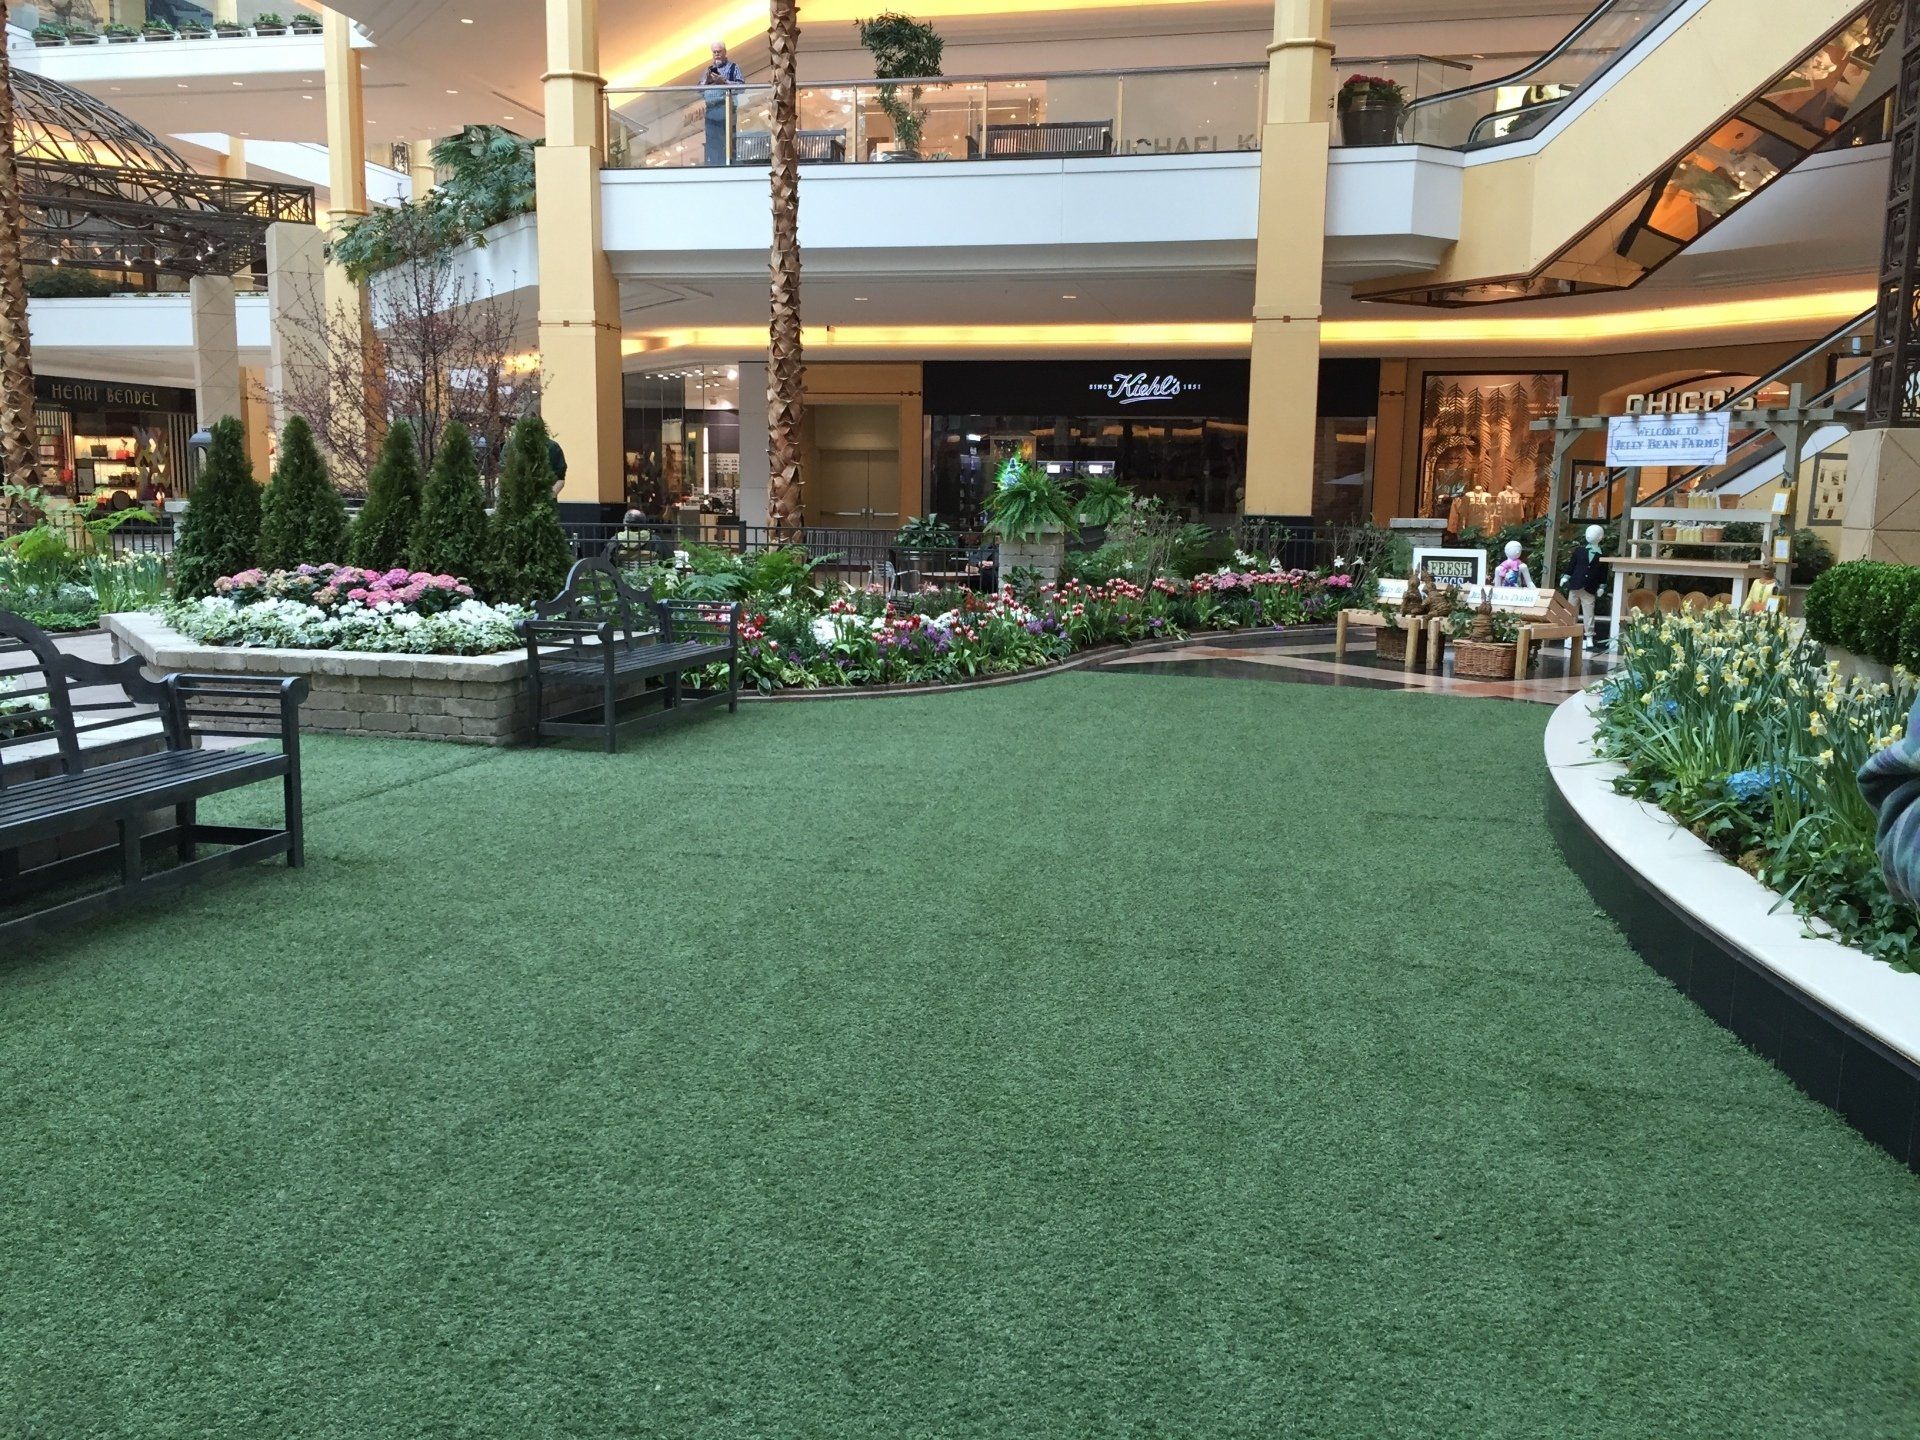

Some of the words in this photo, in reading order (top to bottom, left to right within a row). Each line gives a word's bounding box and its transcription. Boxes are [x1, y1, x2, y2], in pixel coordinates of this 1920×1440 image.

[1107, 373, 1180, 398] Kiehl's
[51, 384, 98, 401] HENRI
[106, 387, 159, 406] BENDEL
[1637, 427, 1681, 437] WELCOME
[1686, 426, 1699, 436] TO
[1615, 440, 1645, 450] JELLY
[1647, 439, 1678, 450] BEAN
[1681, 437, 1720, 449] FARMS
[1431, 561, 1469, 576] FRESH
